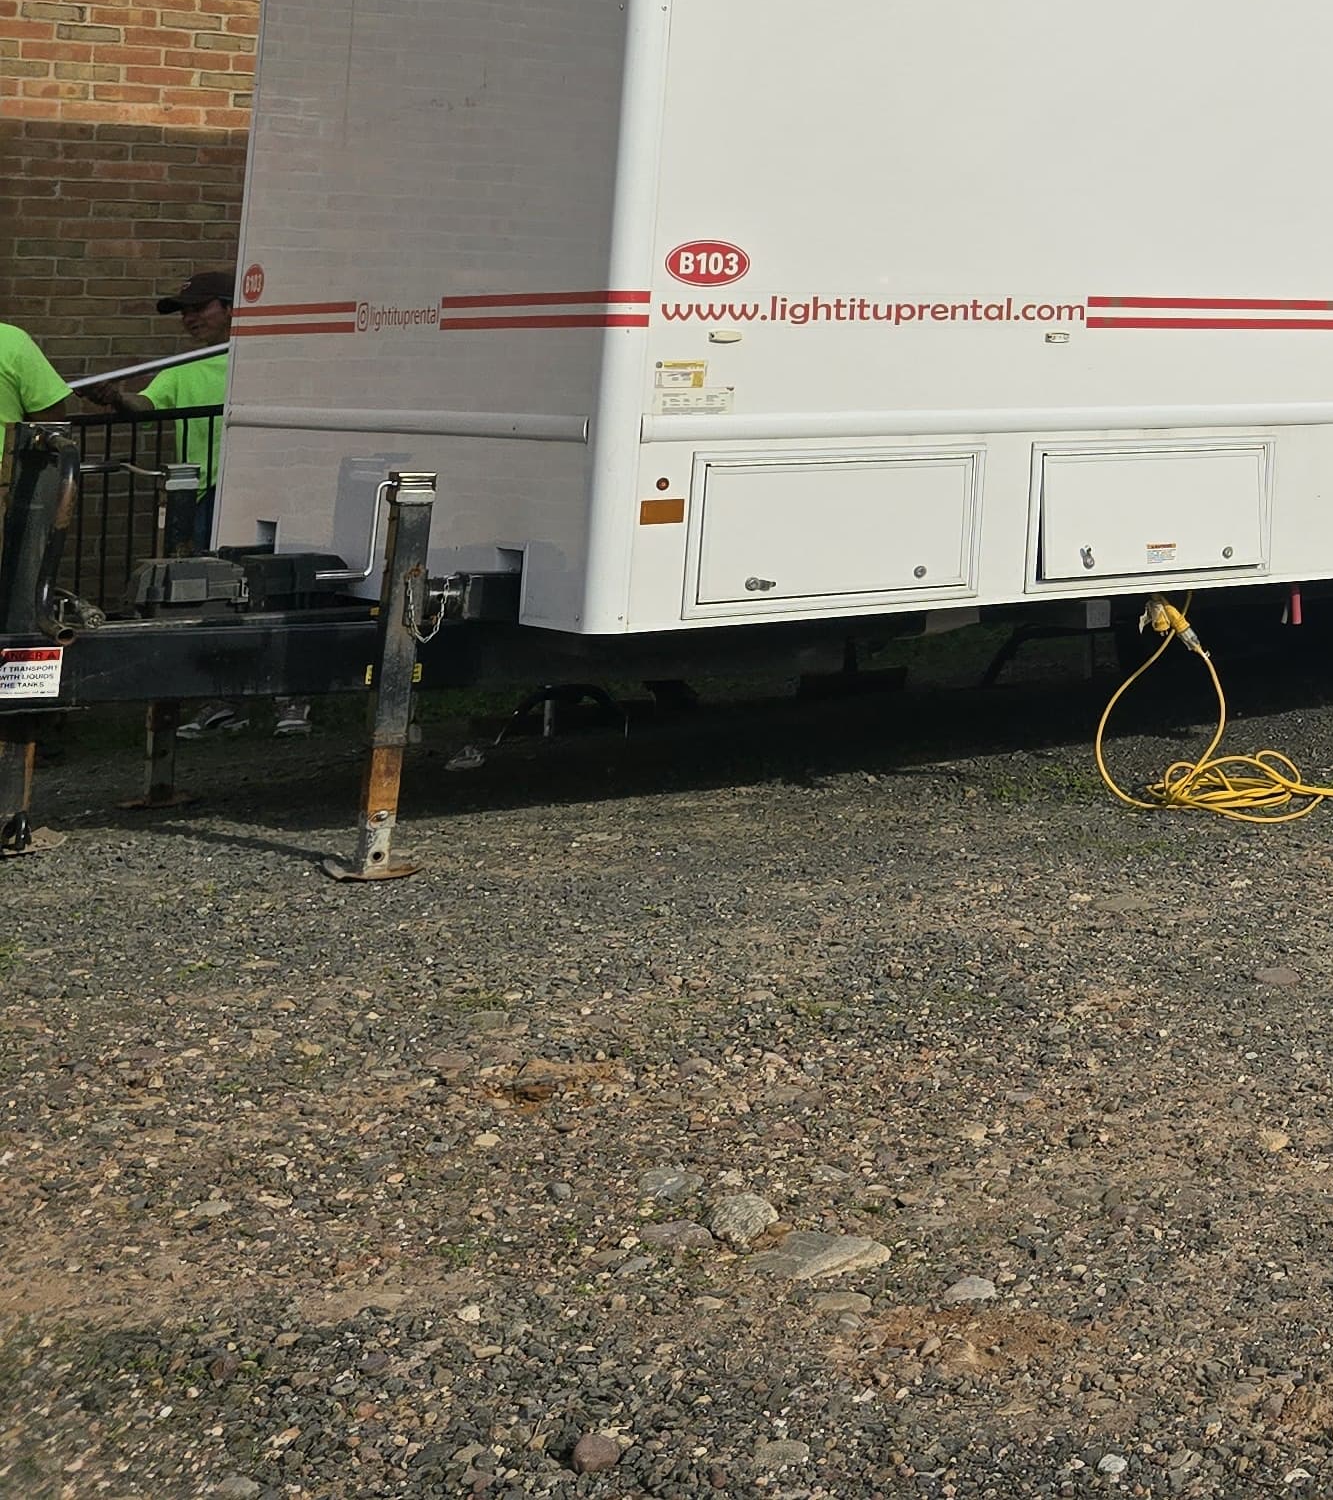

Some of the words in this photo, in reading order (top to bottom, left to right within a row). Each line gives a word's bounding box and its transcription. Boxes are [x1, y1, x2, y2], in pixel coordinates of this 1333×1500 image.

[679, 251, 740, 276] B103
[245, 273, 263, 294] B103
[369, 303, 441, 332] lightituprental
[661, 295, 1085, 326] www.lightituprental.com
[9, 665, 58, 673] TRANSPORT
